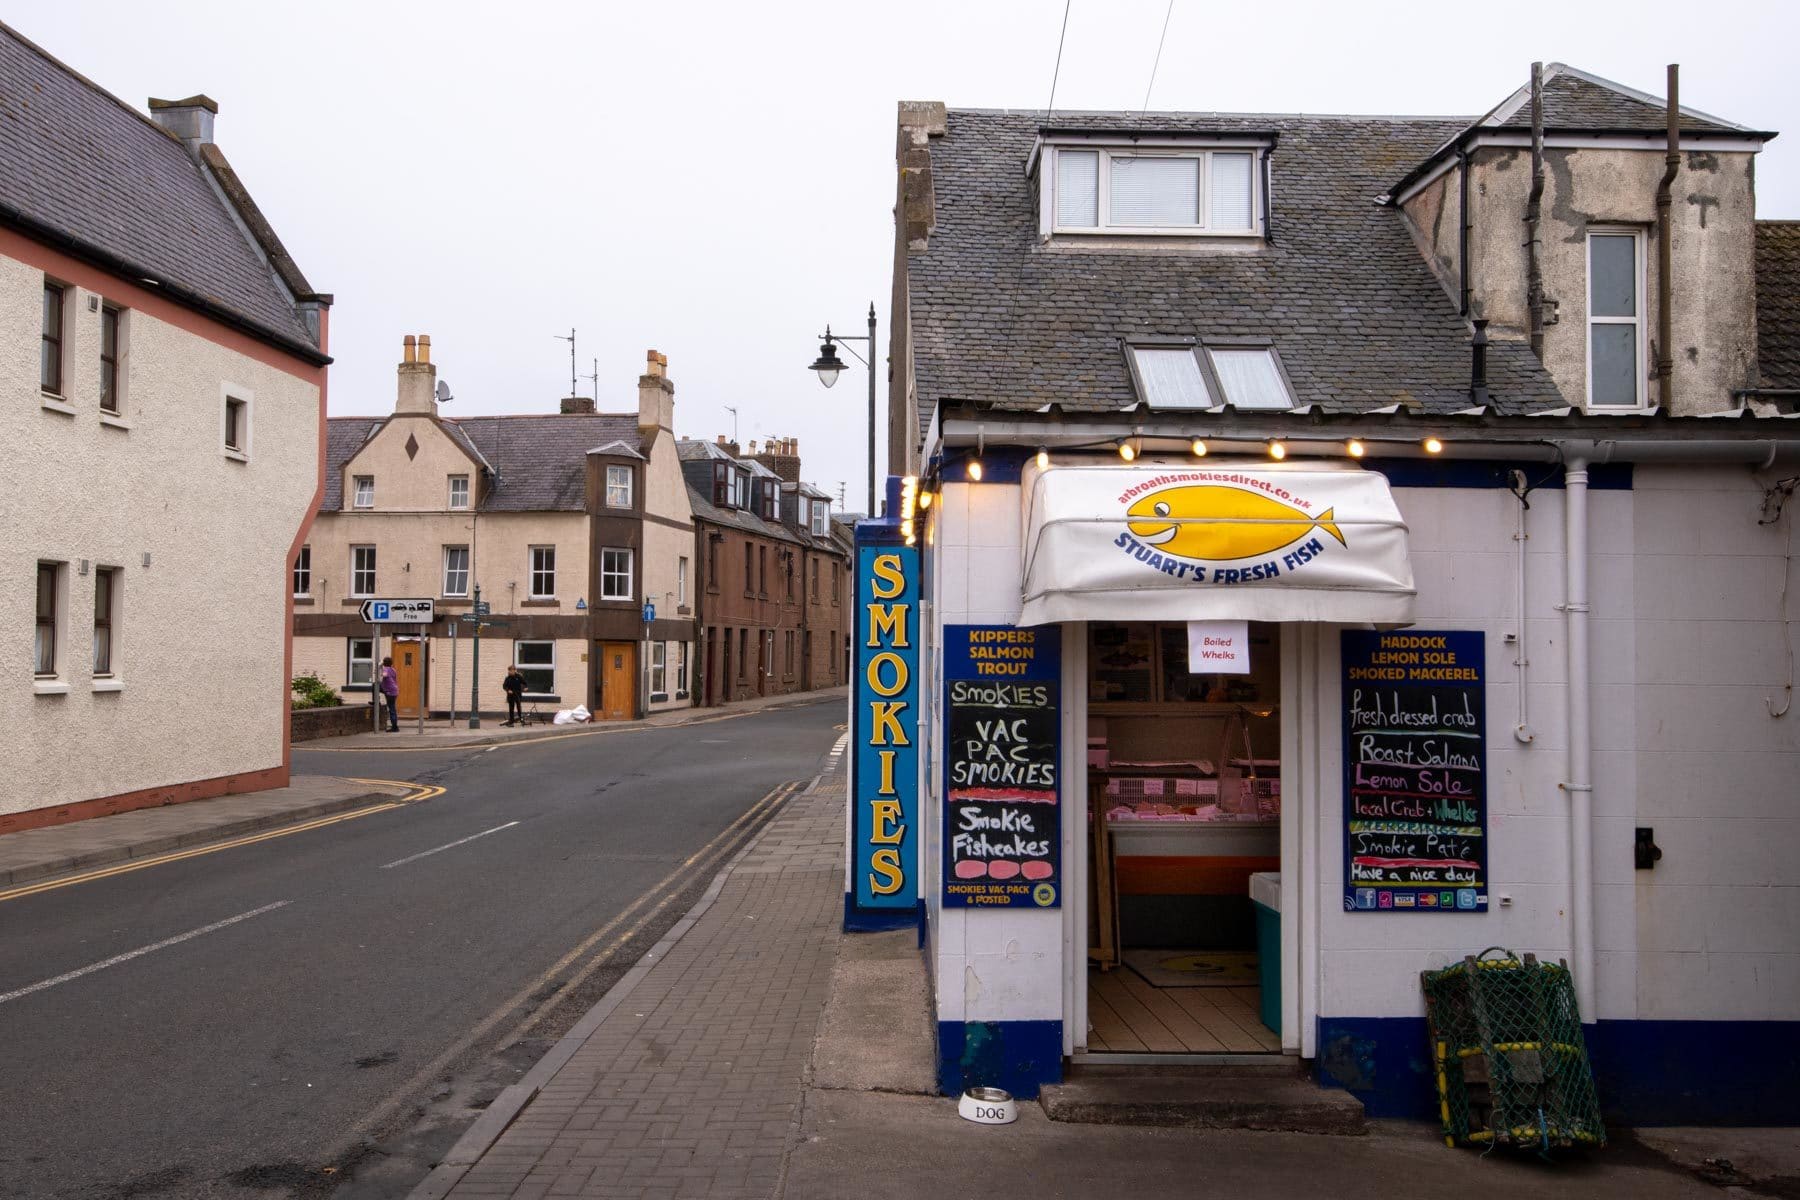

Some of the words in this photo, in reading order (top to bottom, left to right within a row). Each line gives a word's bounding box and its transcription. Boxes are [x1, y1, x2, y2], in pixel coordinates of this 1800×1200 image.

[1118, 472, 1312, 509] arbroathsmokiesdirect.co.uk
[1114, 532, 1206, 582] STUART'S
[1213, 561, 1280, 585] FRESH
[1283, 537, 1324, 571] FISH
[969, 631, 1035, 643] KIPPERS
[1204, 637, 1232, 647] Boiled
[1381, 637, 1446, 648] HADDOCK
[969, 647, 1034, 659] SALMON
[1202, 651, 1235, 660] Whelks
[1371, 652, 1419, 664] LEMON
[1423, 652, 1456, 664] SOLE
[977, 662, 1028, 675] TROUT
[1350, 668, 1405, 680] SMOKED
[1409, 668, 1478, 680] MACKEREL
[1350, 689, 1388, 728] fresh
[1390, 691, 1438, 726] dressed
[1443, 692, 1476, 727] crab
[867, 554, 909, 896] SMOKIES
[976, 719, 1028, 742] VAC
[967, 740, 1029, 761] PAC
[1360, 735, 1414, 763] Roast
[1417, 741, 1479, 768] Salmon
[1356, 763, 1408, 789] Lemon
[1418, 771, 1472, 794] Sole
[953, 832, 1049, 862] Fishcakes
[1356, 833, 1416, 857] Smokie
[1351, 863, 1384, 881] Have
[1389, 872, 1401, 882] a
[1410, 868, 1438, 882] nice
[1445, 866, 1476, 887] day
[947, 885, 986, 894] SMOKIES
[989, 885, 1005, 894] VAC
[1007, 885, 1030, 894] PACK
[976, 896, 1011, 904] POSTED
[976, 1107, 1005, 1120] DOG
